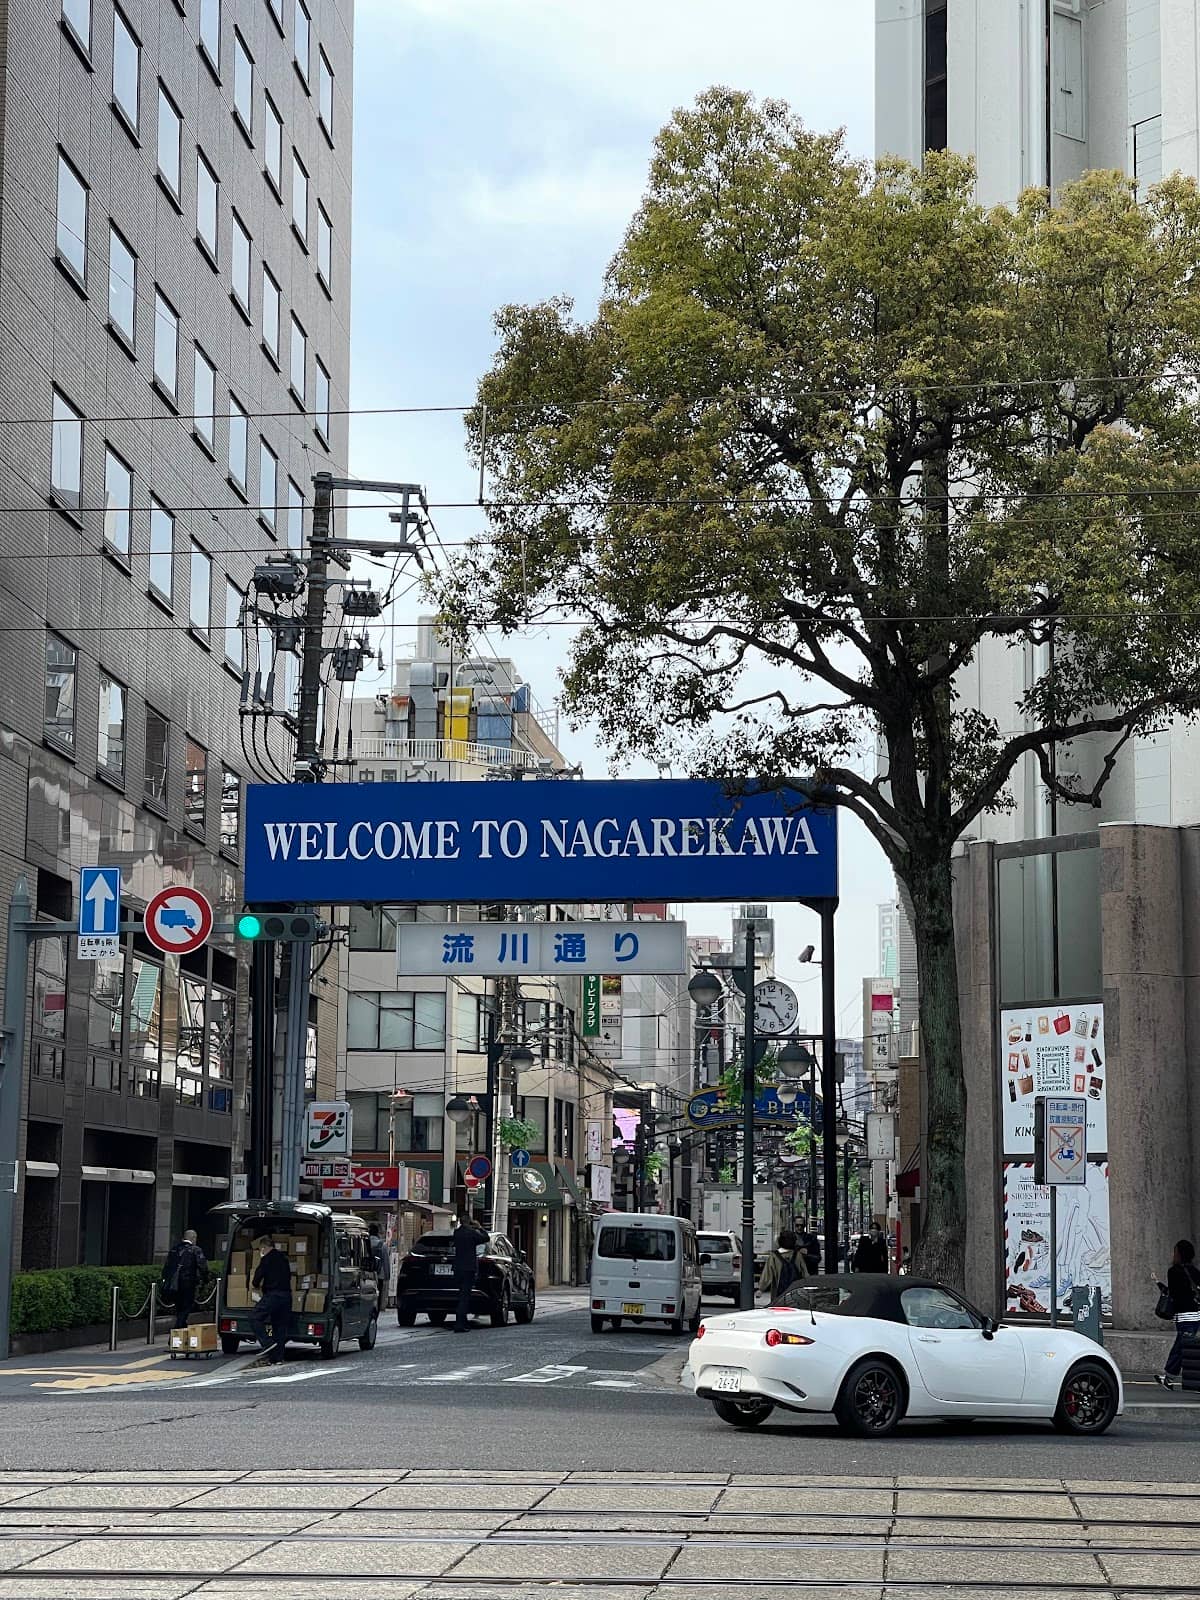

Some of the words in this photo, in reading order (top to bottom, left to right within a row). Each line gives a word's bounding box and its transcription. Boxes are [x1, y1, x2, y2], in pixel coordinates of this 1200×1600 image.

[263, 821, 460, 861] WELCOME
[471, 819, 528, 858] TO
[540, 816, 819, 858] NAGAREKAWA
[442, 932, 639, 964] 流川通り
[81, 949, 116, 957] ここから
[758, 988, 766, 996] 11
[785, 993, 791, 1001] 2
[306, 1164, 319, 1175] ATM
